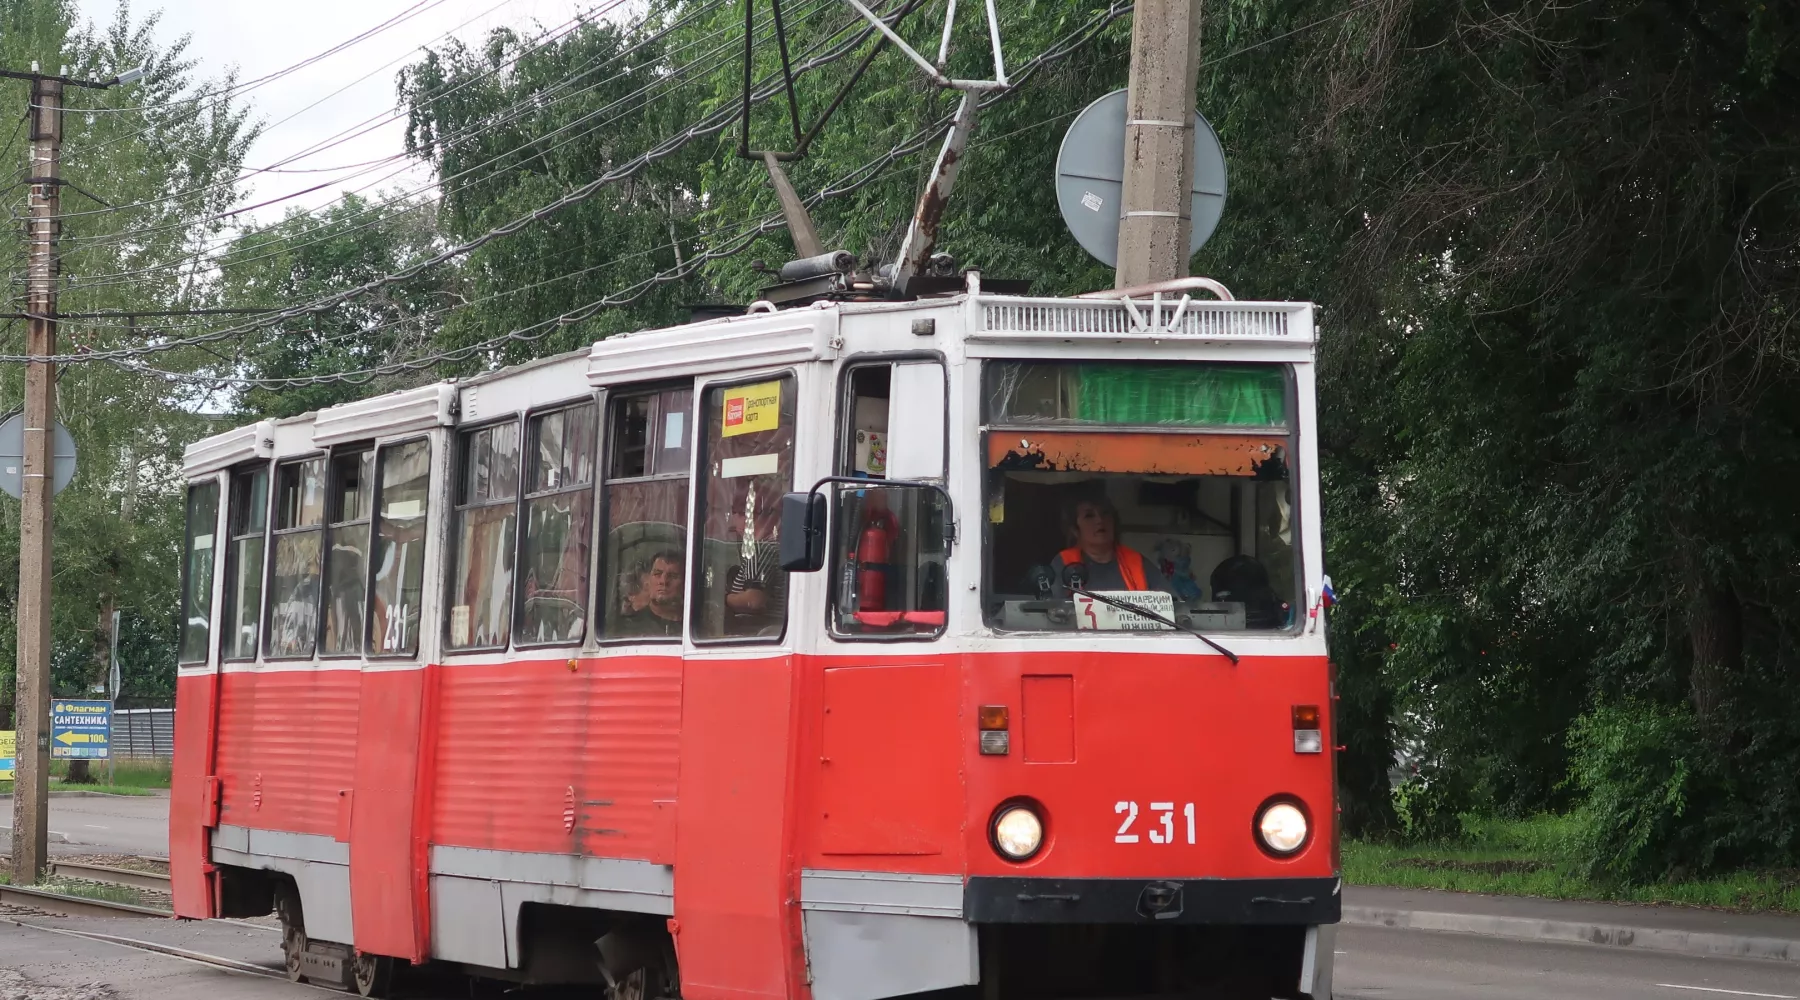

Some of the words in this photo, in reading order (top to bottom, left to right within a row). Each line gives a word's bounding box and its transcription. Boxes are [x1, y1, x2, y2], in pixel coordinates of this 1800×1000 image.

[746, 396, 777, 409] Транспортная
[746, 413, 759, 422] карта
[384, 604, 408, 650] 231
[65, 704, 106, 713] Флагман
[54, 715, 107, 725] САНТЕХНИКА
[1115, 801, 1196, 844] 231
